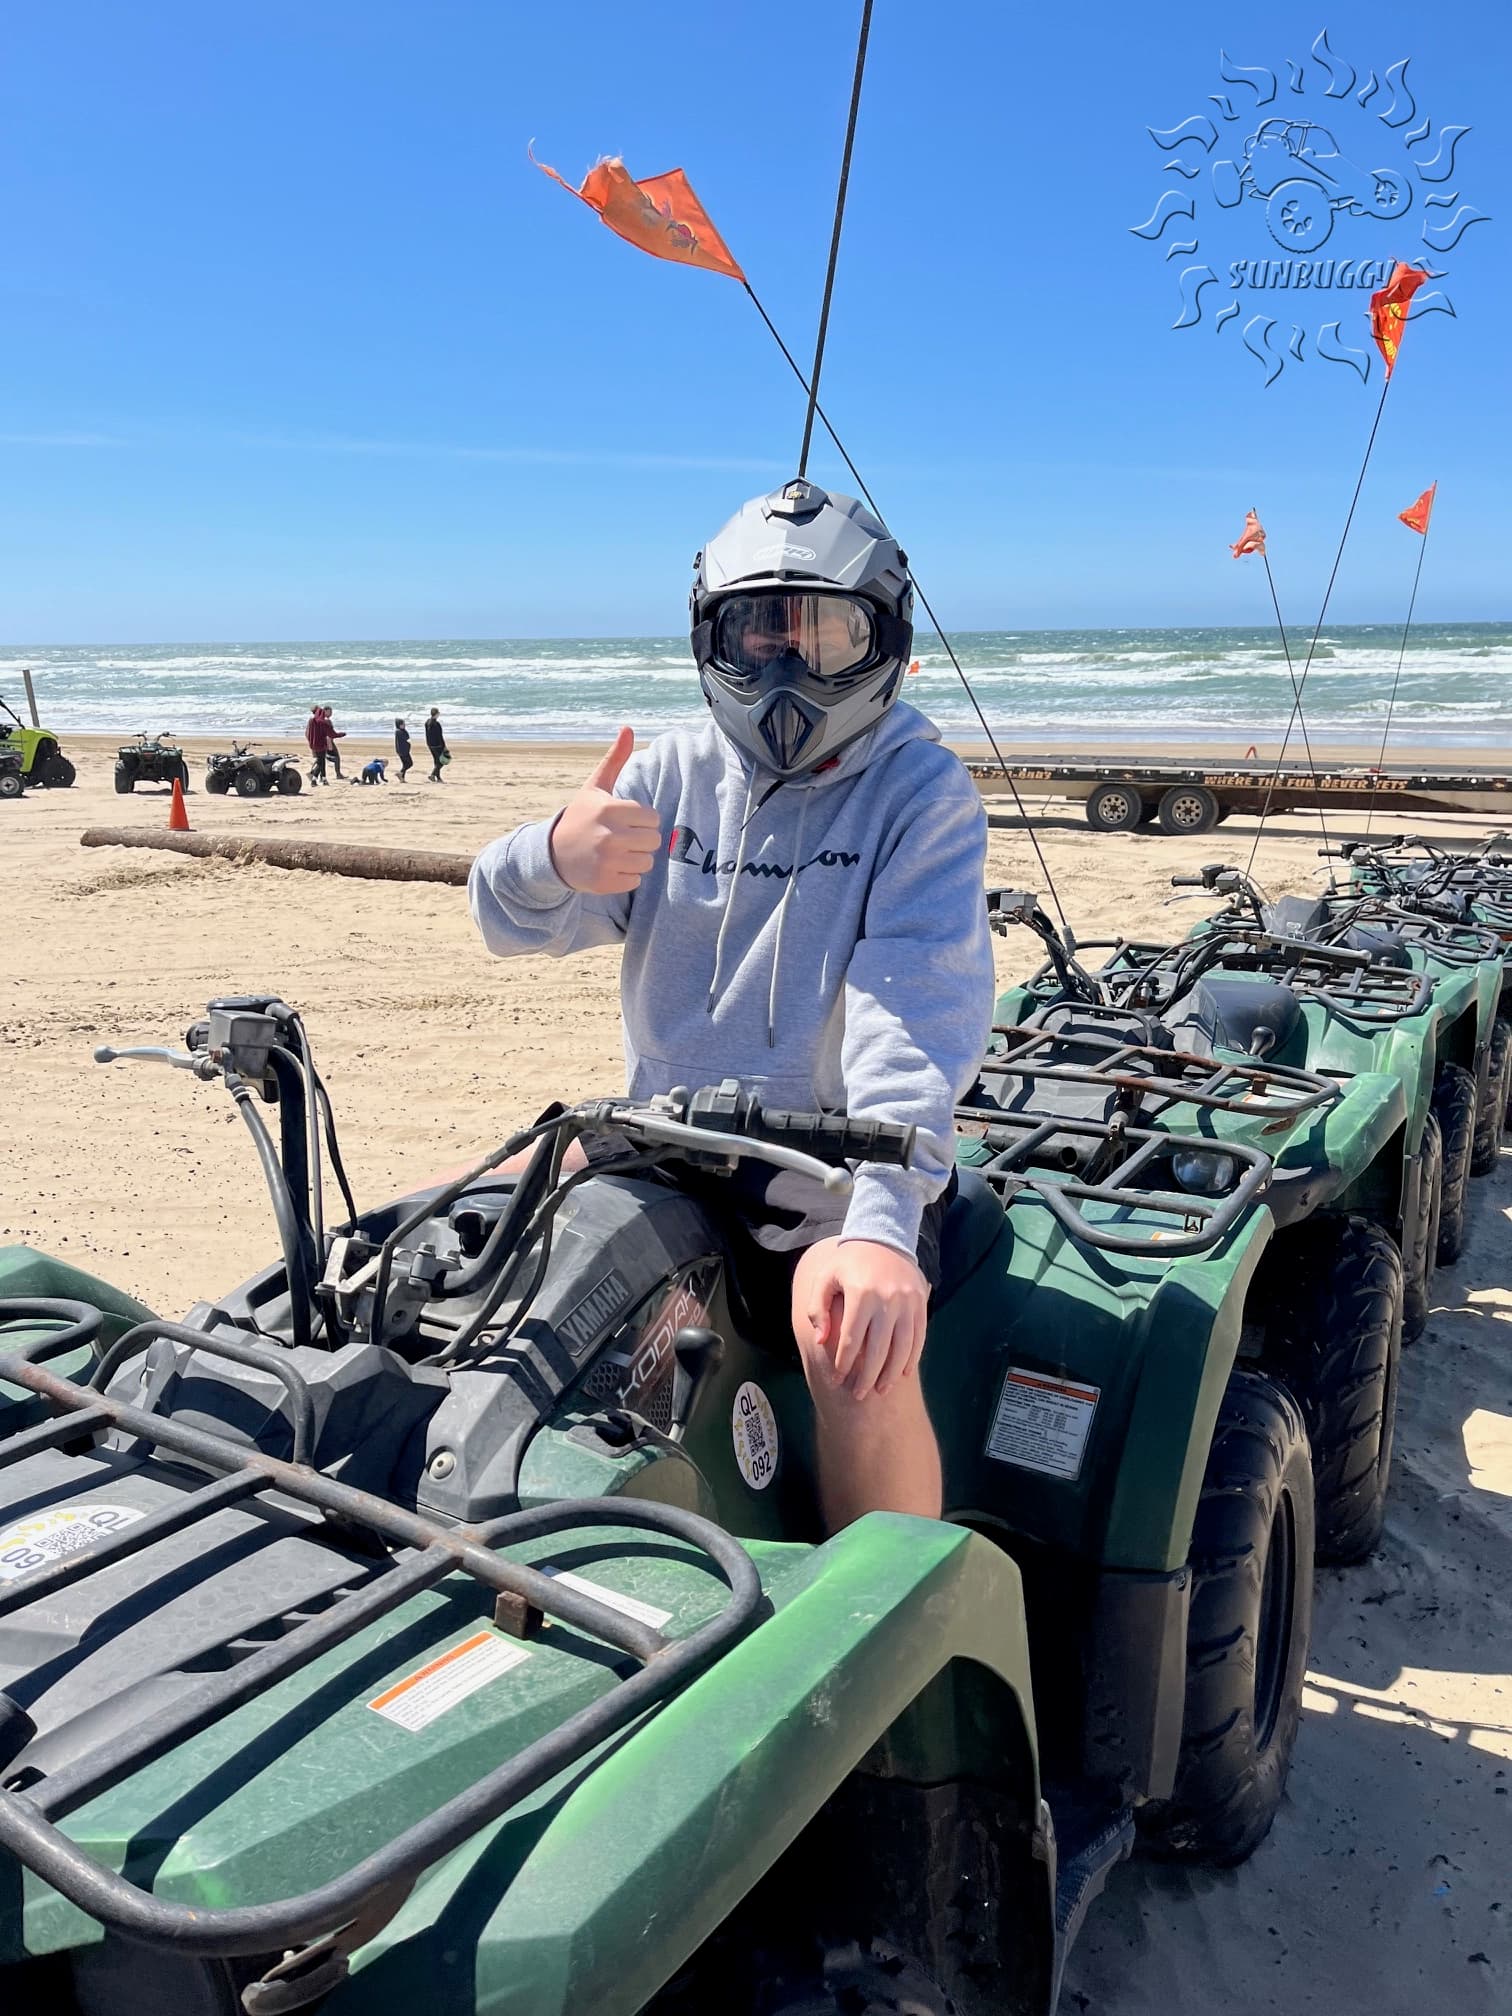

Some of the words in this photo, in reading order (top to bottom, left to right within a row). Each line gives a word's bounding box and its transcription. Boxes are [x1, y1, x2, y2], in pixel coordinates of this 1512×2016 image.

[1204, 775, 1254, 786] WHERE
[1258, 777, 1284, 787] THE
[1286, 778, 1316, 788] FUN
[1321, 779, 1369, 789] NEVER
[669, 824, 861, 879] Chamon
[559, 1273, 630, 1346] YAMAHA
[615, 1275, 697, 1409] KODIAK
[740, 1391, 757, 1417] QL
[752, 1451, 772, 1481] 092
[88, 1511, 129, 1531] QL
